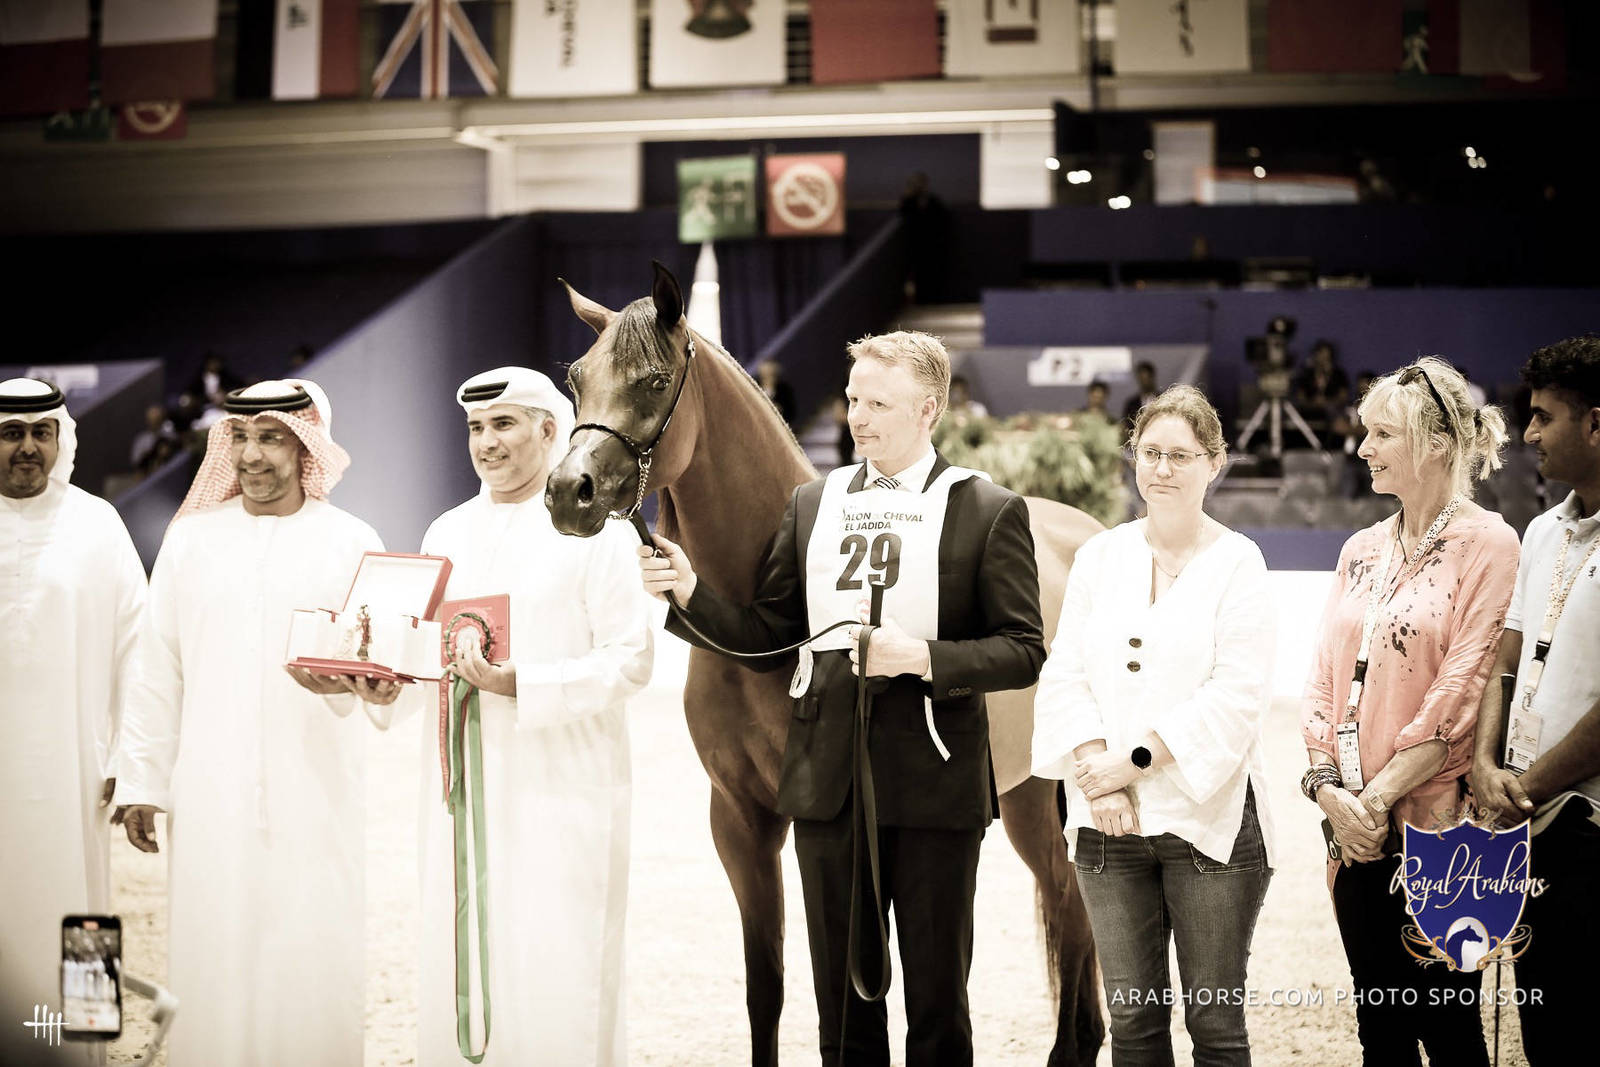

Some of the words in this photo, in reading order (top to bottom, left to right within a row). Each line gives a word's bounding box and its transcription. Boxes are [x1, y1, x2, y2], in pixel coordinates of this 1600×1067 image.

[884, 511, 923, 522] CHEVAL
[856, 521, 891, 531] JADIDA
[836, 533, 902, 590] 29
